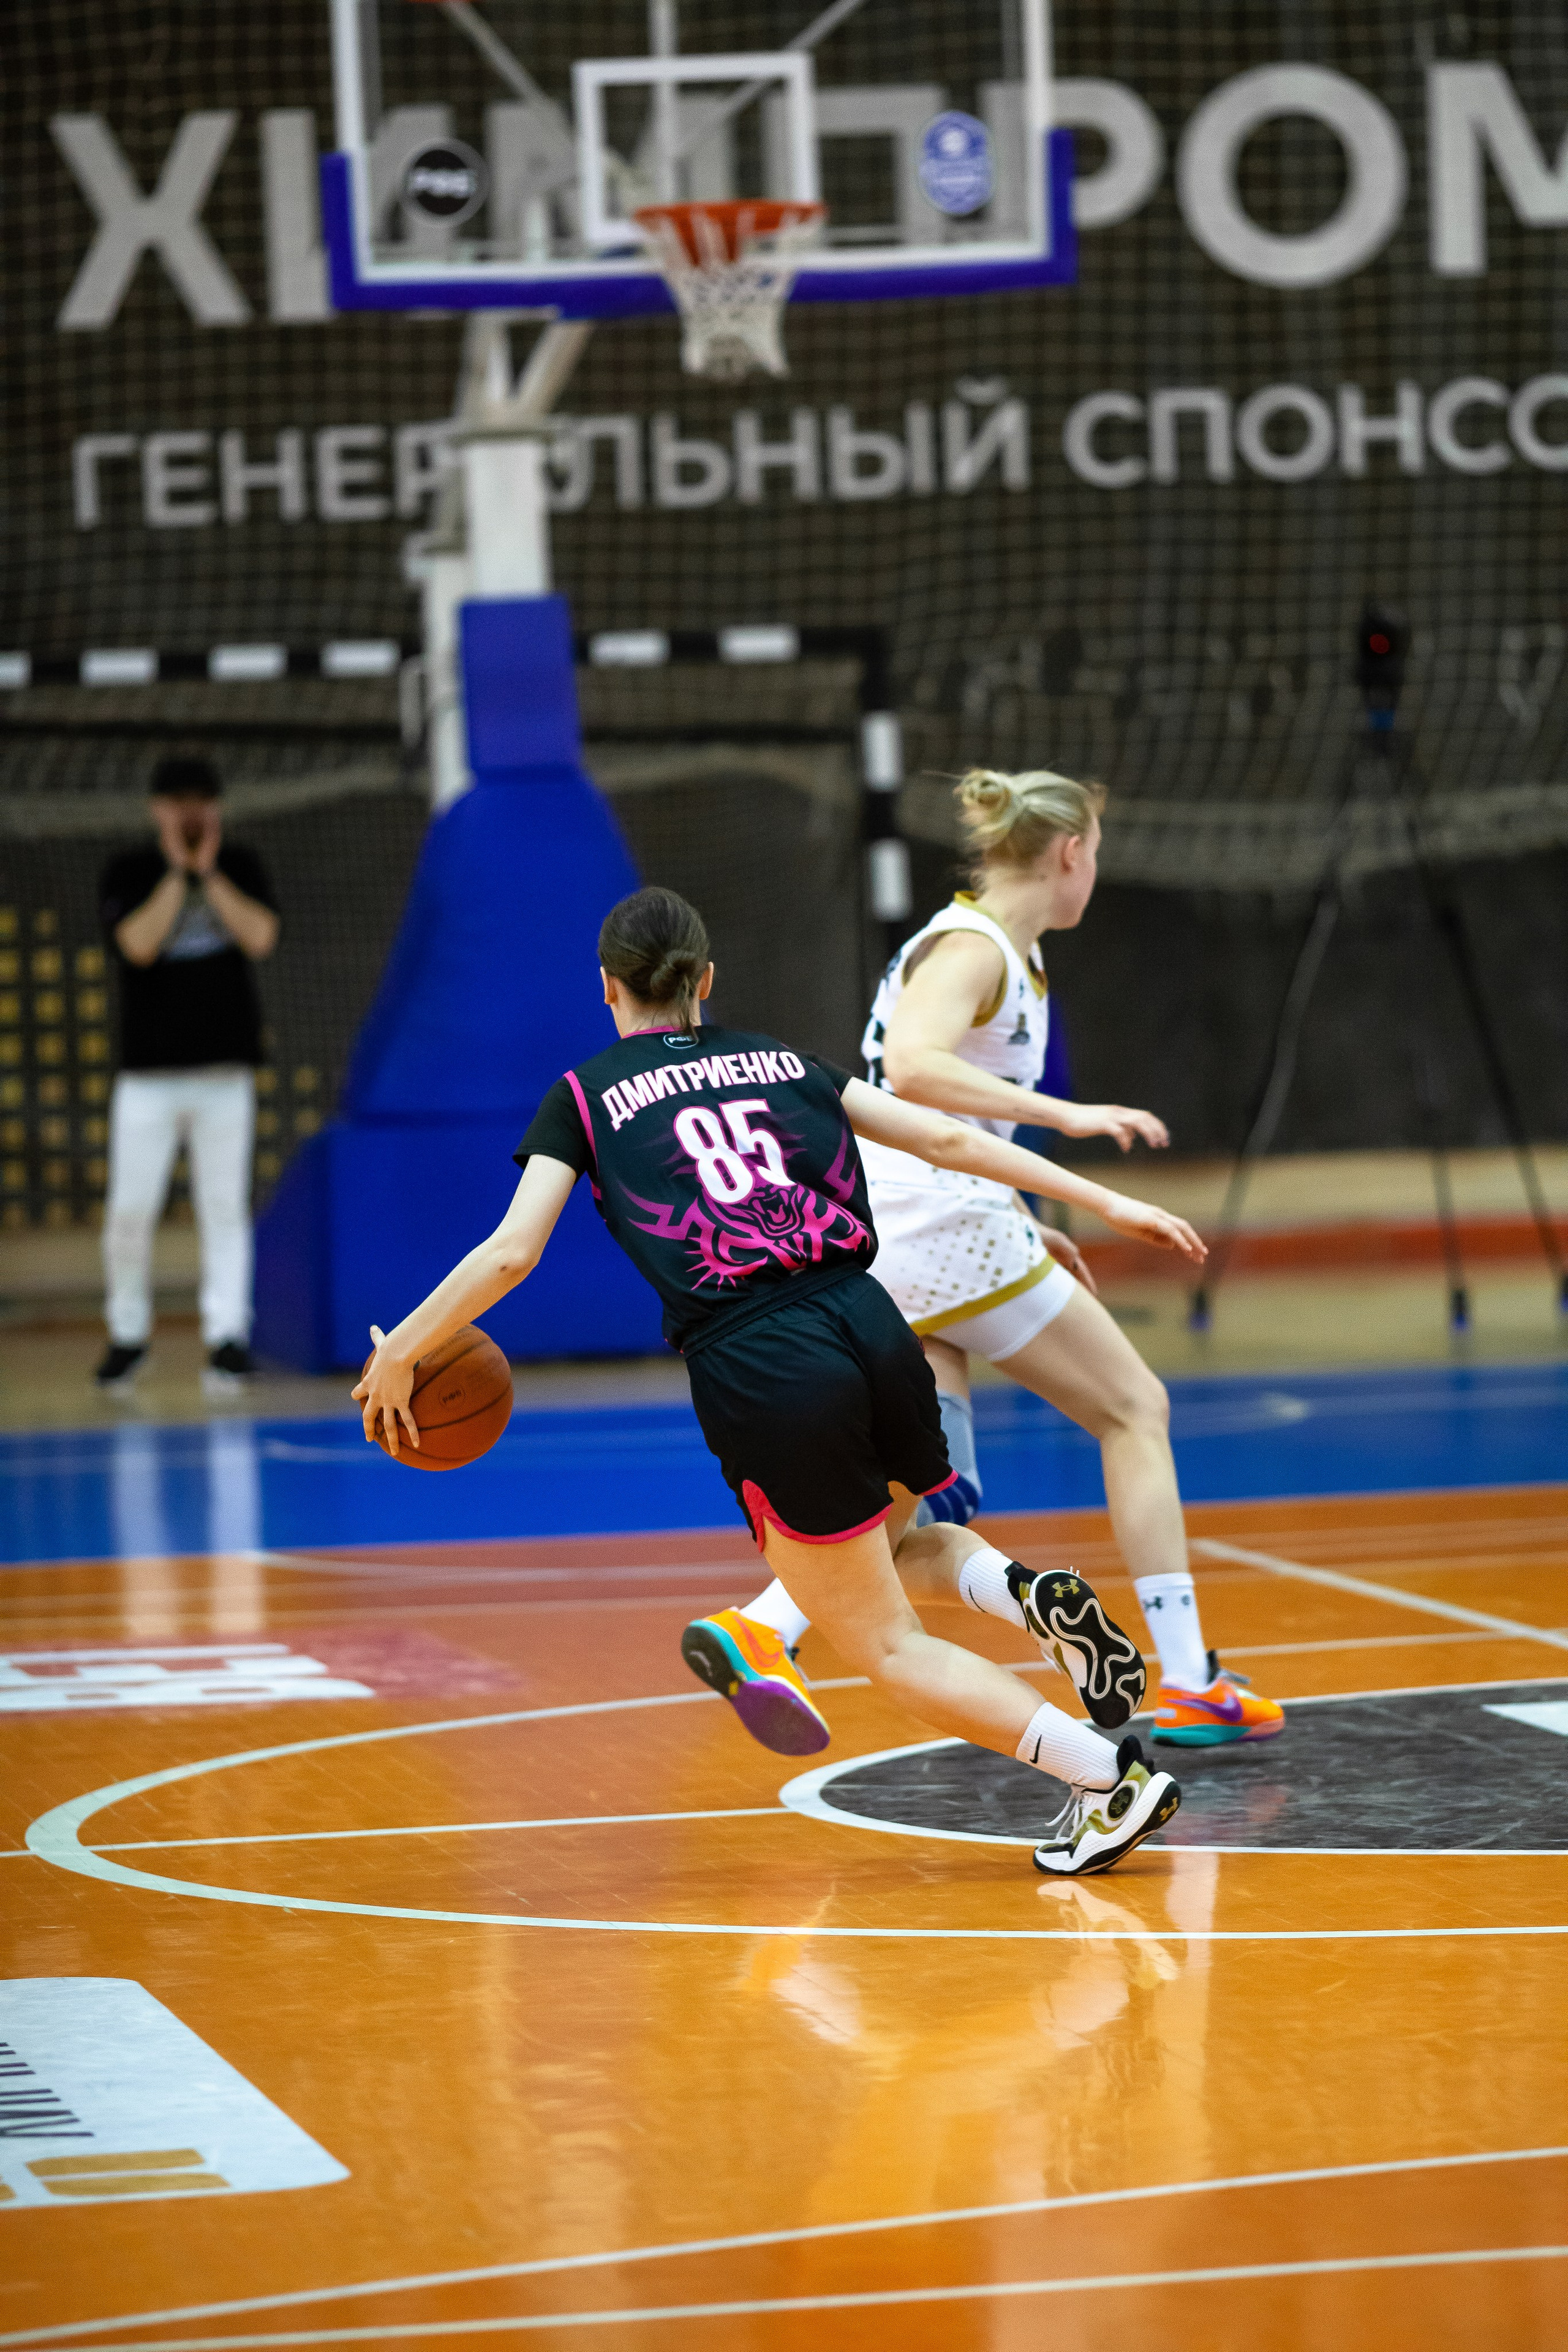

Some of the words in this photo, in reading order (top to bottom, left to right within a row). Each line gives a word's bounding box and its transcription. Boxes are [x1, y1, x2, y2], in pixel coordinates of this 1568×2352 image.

[72, 375, 1031, 530] ГЕНЕРЛЬНЫЙ
[601, 1050, 807, 1132] ДМИТРИЕНКО
[674, 1098, 797, 1205] 85
